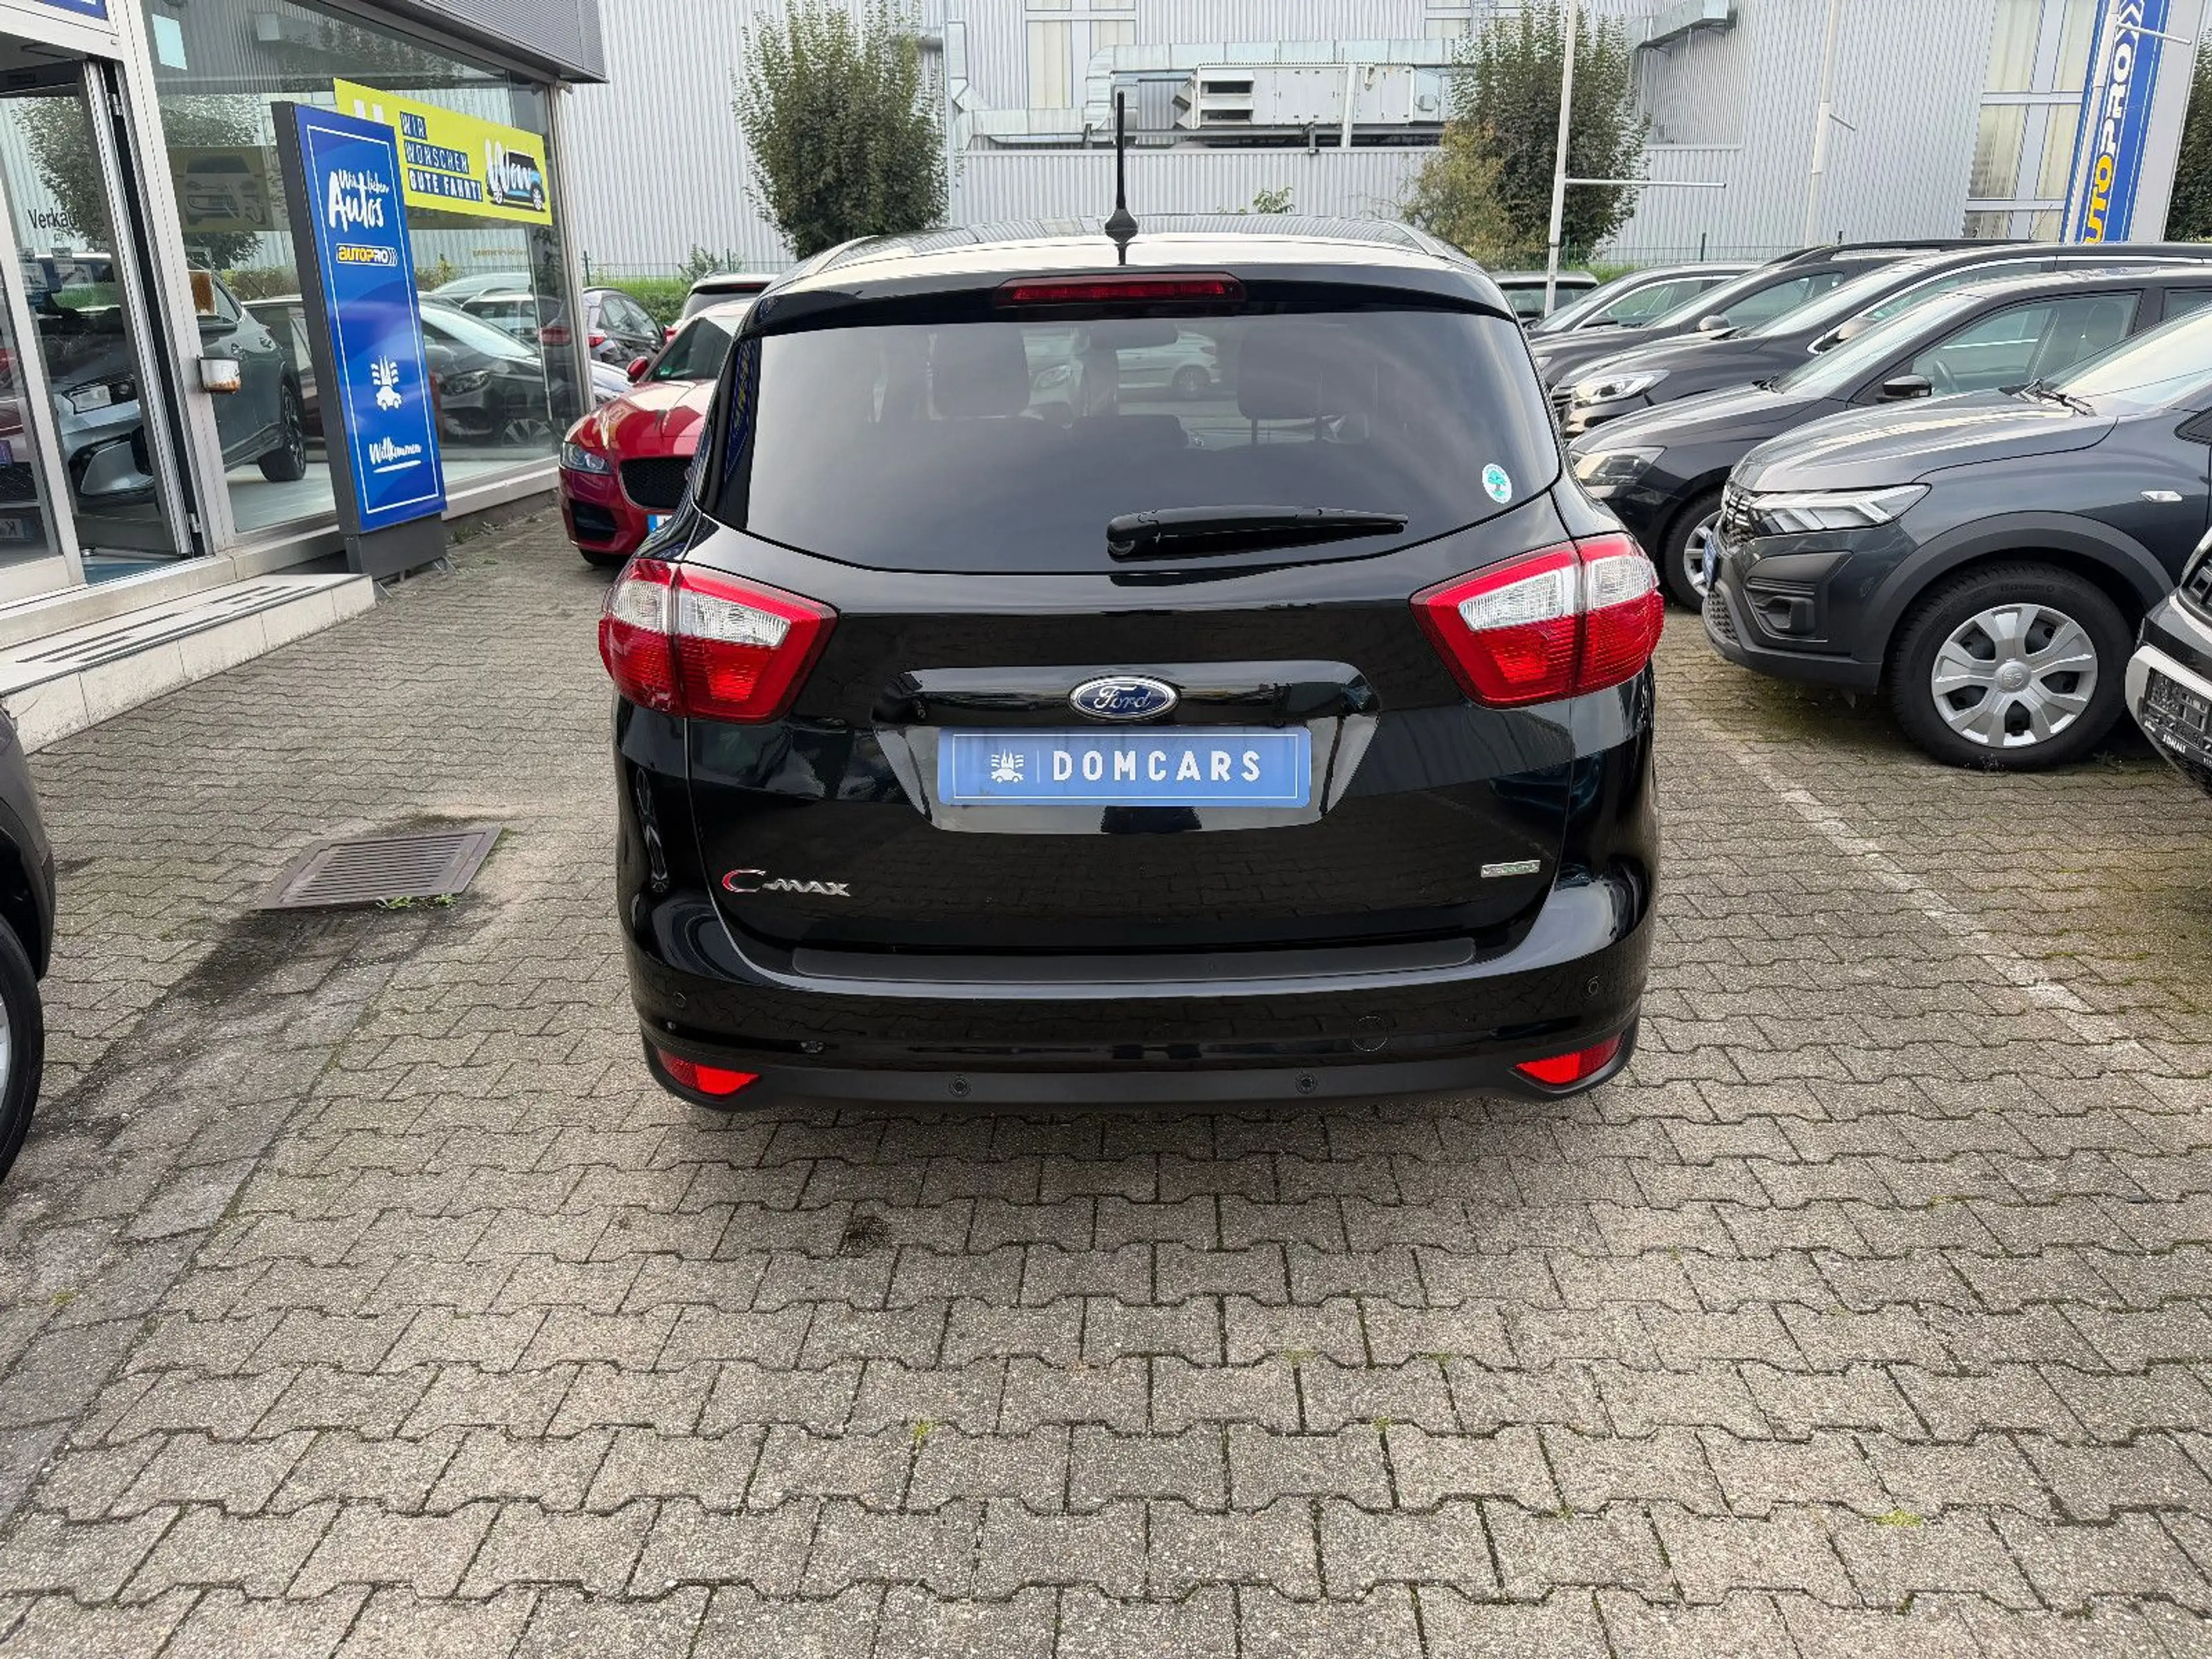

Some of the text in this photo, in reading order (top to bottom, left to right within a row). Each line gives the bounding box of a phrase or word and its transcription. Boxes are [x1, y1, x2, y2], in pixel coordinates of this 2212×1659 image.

[401, 113, 425, 138] WIR
[2084, 43, 2134, 244] UTOPRO
[409, 170, 440, 194] GUTE
[328, 170, 385, 233] Autos
[26, 207, 81, 229] Verkau
[1093, 683, 1151, 710] Ford
[1052, 749, 1262, 783] DOMCARS
